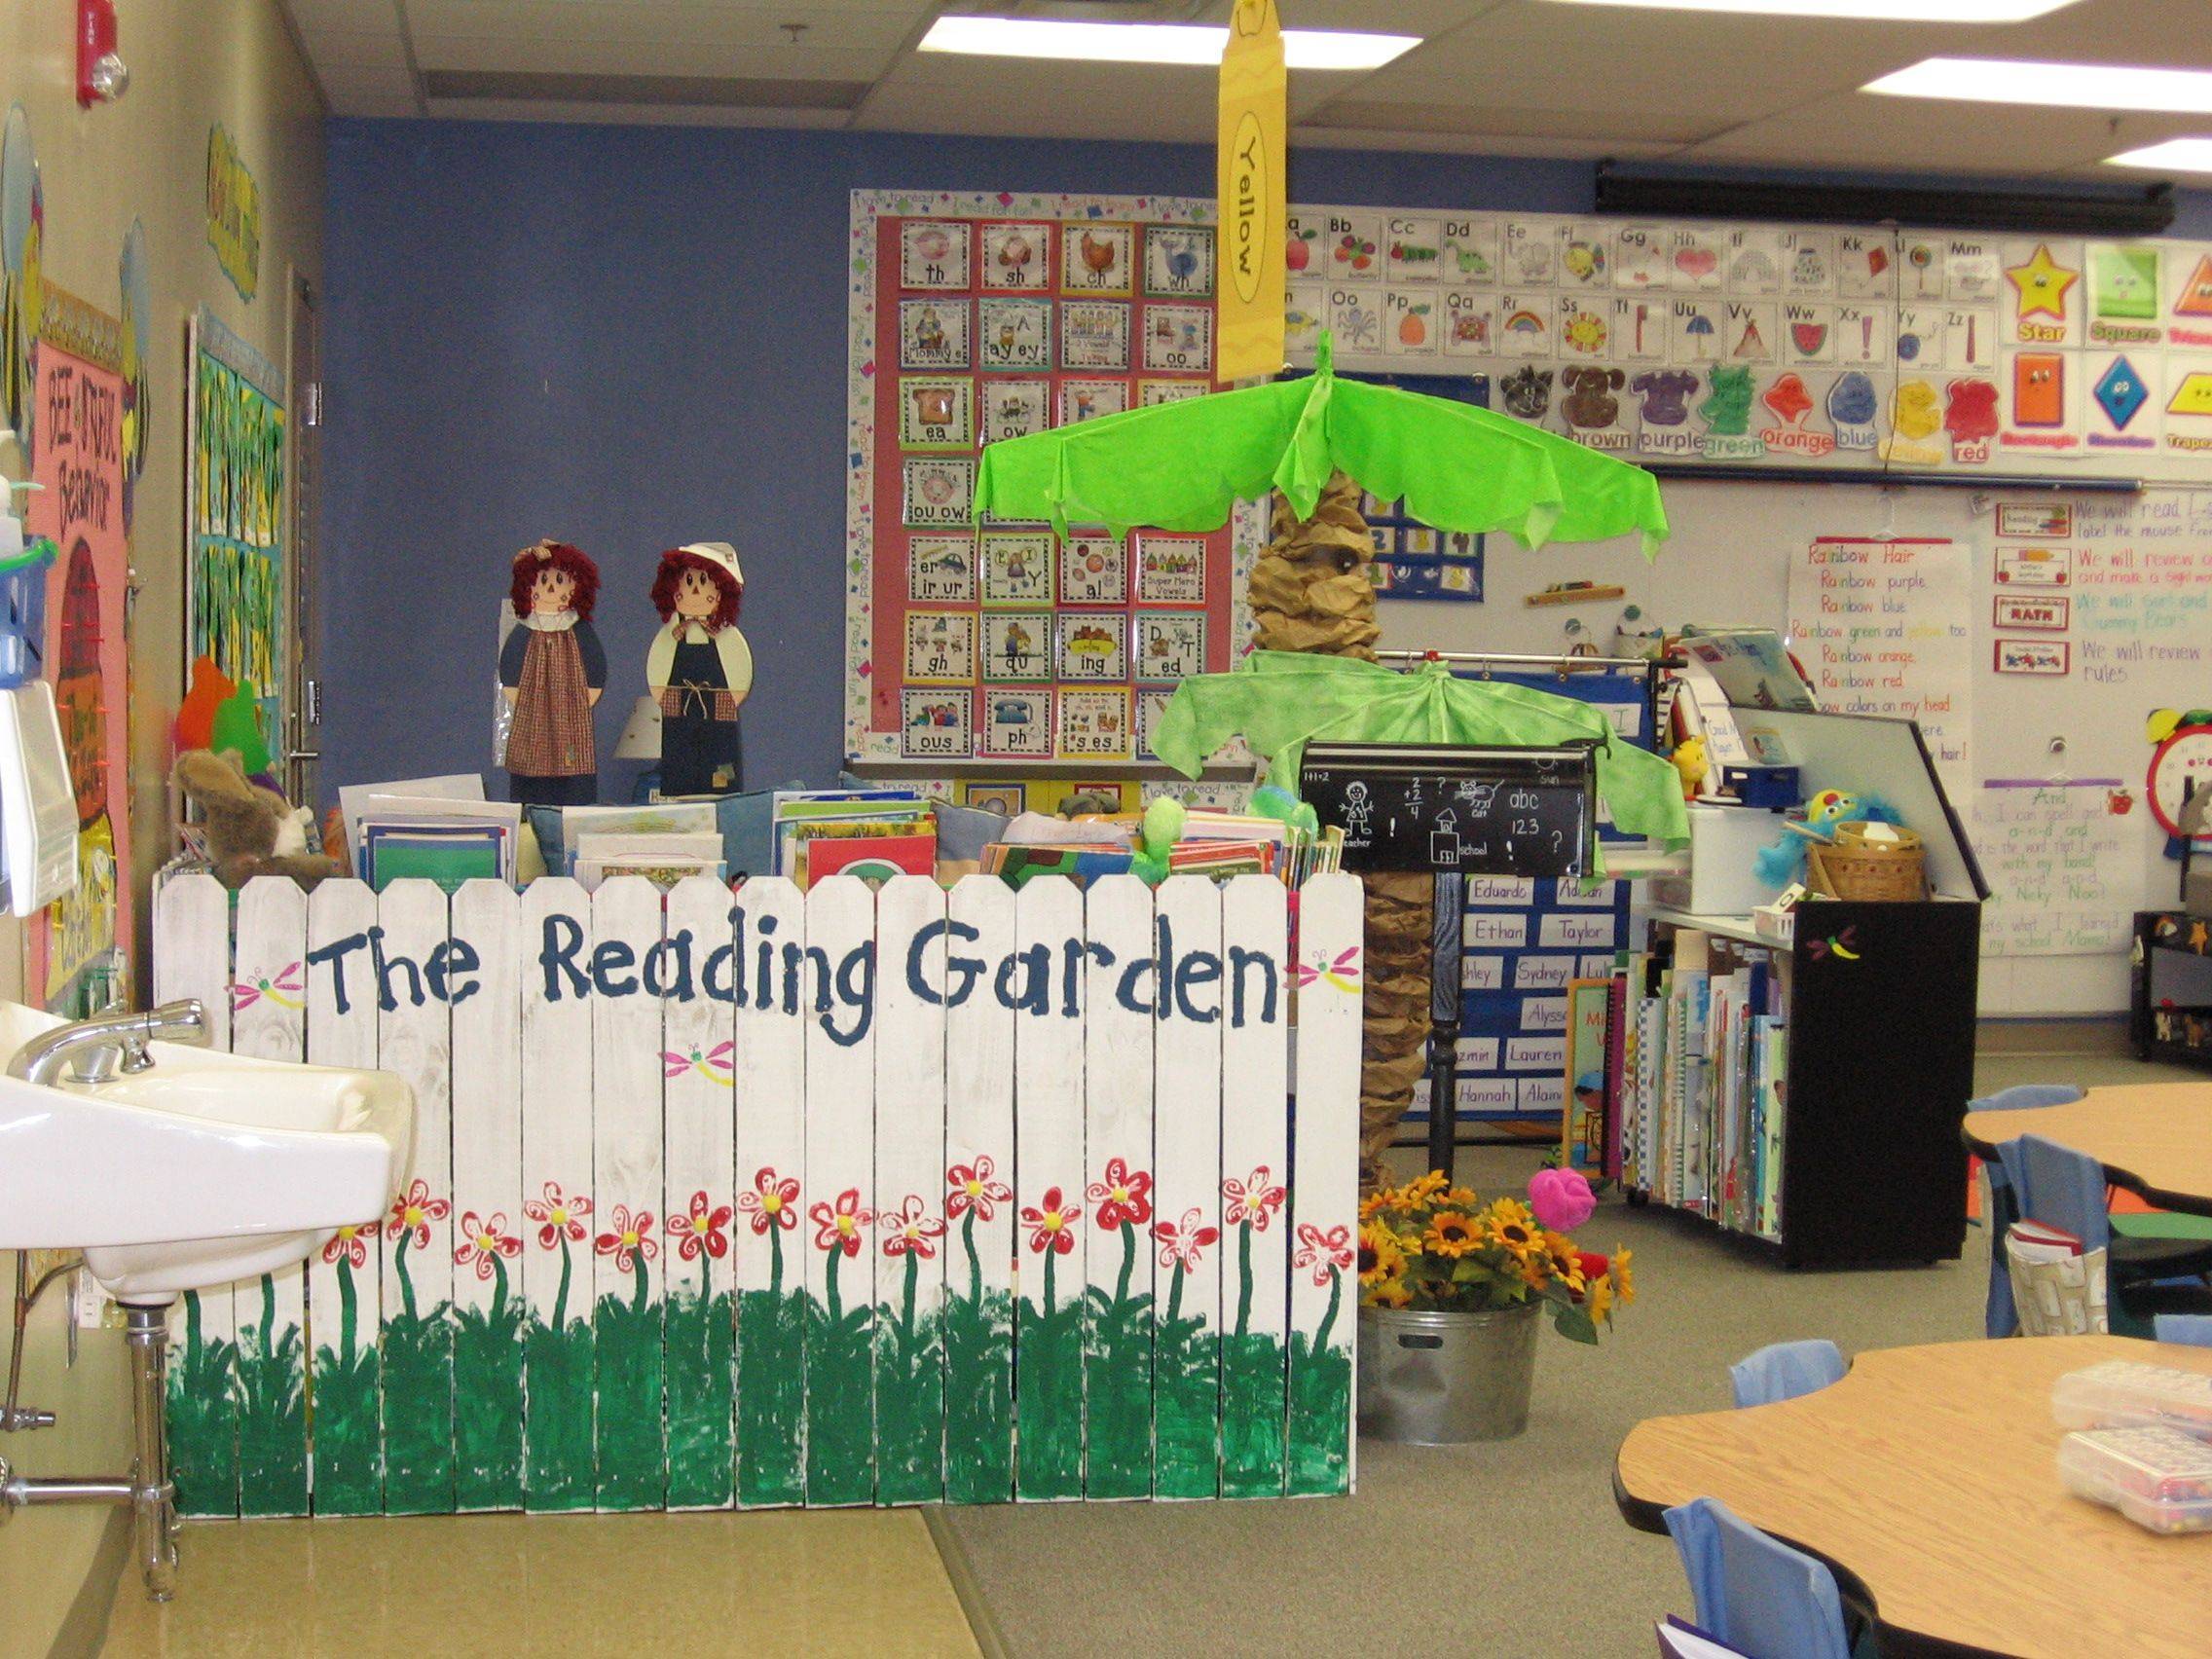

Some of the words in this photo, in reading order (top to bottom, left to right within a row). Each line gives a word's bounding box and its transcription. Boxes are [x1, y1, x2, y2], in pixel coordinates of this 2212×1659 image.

[1238, 136, 1256, 276] Yellow
[1286, 218, 1300, 232] a
[1330, 217, 1352, 234] Bb
[1390, 219, 1415, 236] Cc
[1446, 220, 1470, 238] Dd
[1506, 223, 1527, 240] Ee
[1562, 226, 1574, 241] Ff
[1621, 228, 1646, 246] Gg
[1674, 232, 1696, 246] Hh
[1730, 233, 1743, 246] Ii
[1785, 234, 1797, 250] Jj
[1842, 236, 1862, 251] Kk
[1895, 239, 1906, 253] Ll
[1951, 242, 1982, 256] Mm
[926, 263, 944, 282] th
[1006, 265, 1024, 284] sh
[1087, 266, 1107, 286] ch
[1168, 272, 1191, 289] wh
[1331, 291, 1358, 307] Oo
[1387, 292, 1409, 311] Pp
[1447, 293, 1473, 312] Qq
[1502, 293, 1518, 310] Rr
[1562, 297, 1578, 313] Ss
[1616, 299, 1629, 314] Tt
[1675, 301, 1697, 317] Uu
[1728, 304, 1752, 320] Vv
[1787, 305, 1816, 320] Ww
[1838, 307, 1861, 322] Xx
[1899, 309, 1916, 327] Yy
[1948, 312, 1965, 327] Zz
[2017, 322, 2068, 342] Star
[908, 347, 952, 360] Mommy
[989, 343, 1013, 361] ay
[1017, 344, 1040, 361] ey
[1165, 352, 1188, 365] oo
[926, 425, 946, 439] ea
[1004, 424, 1028, 438] ow
[1571, 430, 1632, 447] brown
[1836, 427, 1878, 446] blue
[1640, 431, 1704, 453] purple
[1704, 437, 1766, 457] green
[1764, 429, 1834, 453] orange
[1956, 444, 1989, 461] red
[913, 504, 936, 519] ou
[940, 504, 965, 519] ow
[2076, 499, 2095, 519] We
[2142, 497, 2181, 519] read
[1808, 544, 1869, 565] Rainbow
[1883, 543, 1915, 564] Hair
[2079, 548, 2101, 568] We
[2110, 547, 2134, 569] will
[920, 561, 939, 574] er
[923, 578, 937, 595] ir
[942, 583, 963, 595] ur
[1028, 570, 1043, 587] Y
[1147, 575, 1173, 587] Super
[1821, 570, 1876, 588] Rainbow
[1087, 578, 1102, 598] al
[1155, 586, 1188, 596] Vowels
[1821, 595, 1874, 613] Rainbow
[2009, 607, 2054, 622] MATH
[1150, 624, 1162, 642] D
[1791, 619, 1843, 639] Rainbow
[1850, 626, 1880, 645] green
[1885, 622, 1903, 638] and
[1181, 642, 1196, 658] T
[1823, 644, 1872, 663] Rainbow
[2116, 640, 2142, 661] will
[2149, 645, 2201, 661] review
[929, 655, 948, 673] gh
[1006, 654, 1029, 673] qu
[1081, 654, 1106, 674] ing
[1161, 657, 1182, 674] ed
[1823, 669, 1874, 687] Rainbow
[2083, 663, 2128, 682] rules
[1846, 695, 1879, 713] colors
[1882, 701, 1897, 713] on
[1900, 701, 1920, 718] my
[1924, 693, 1951, 712] head
[920, 734, 952, 749] ous
[1009, 729, 1028, 749] ph
[1076, 736, 1087, 749] s
[1092, 736, 1113, 749] es
[1940, 741, 1968, 760] hair!
[1194, 783, 1222, 795] read
[1412, 776, 1420, 790] 2
[1509, 789, 1540, 811] abc
[2032, 788, 2067, 804] And
[1410, 805, 1419, 820] 4
[1471, 808, 1488, 819] cat
[1511, 819, 1539, 835] 123
[1344, 837, 1372, 848] eacher
[1459, 841, 1488, 857] school
[1474, 879, 1528, 899] Eduardo
[1475, 919, 1523, 940] Ethan
[1559, 919, 1604, 945] Taylor
[308, 926, 480, 1014] The
[538, 905, 875, 1047] Reading
[905, 913, 1277, 1028] Garden
[1517, 961, 1568, 986] Sydney
[1510, 1046, 1563, 1061] Lauren
[1460, 1085, 1511, 1102] Hannah
